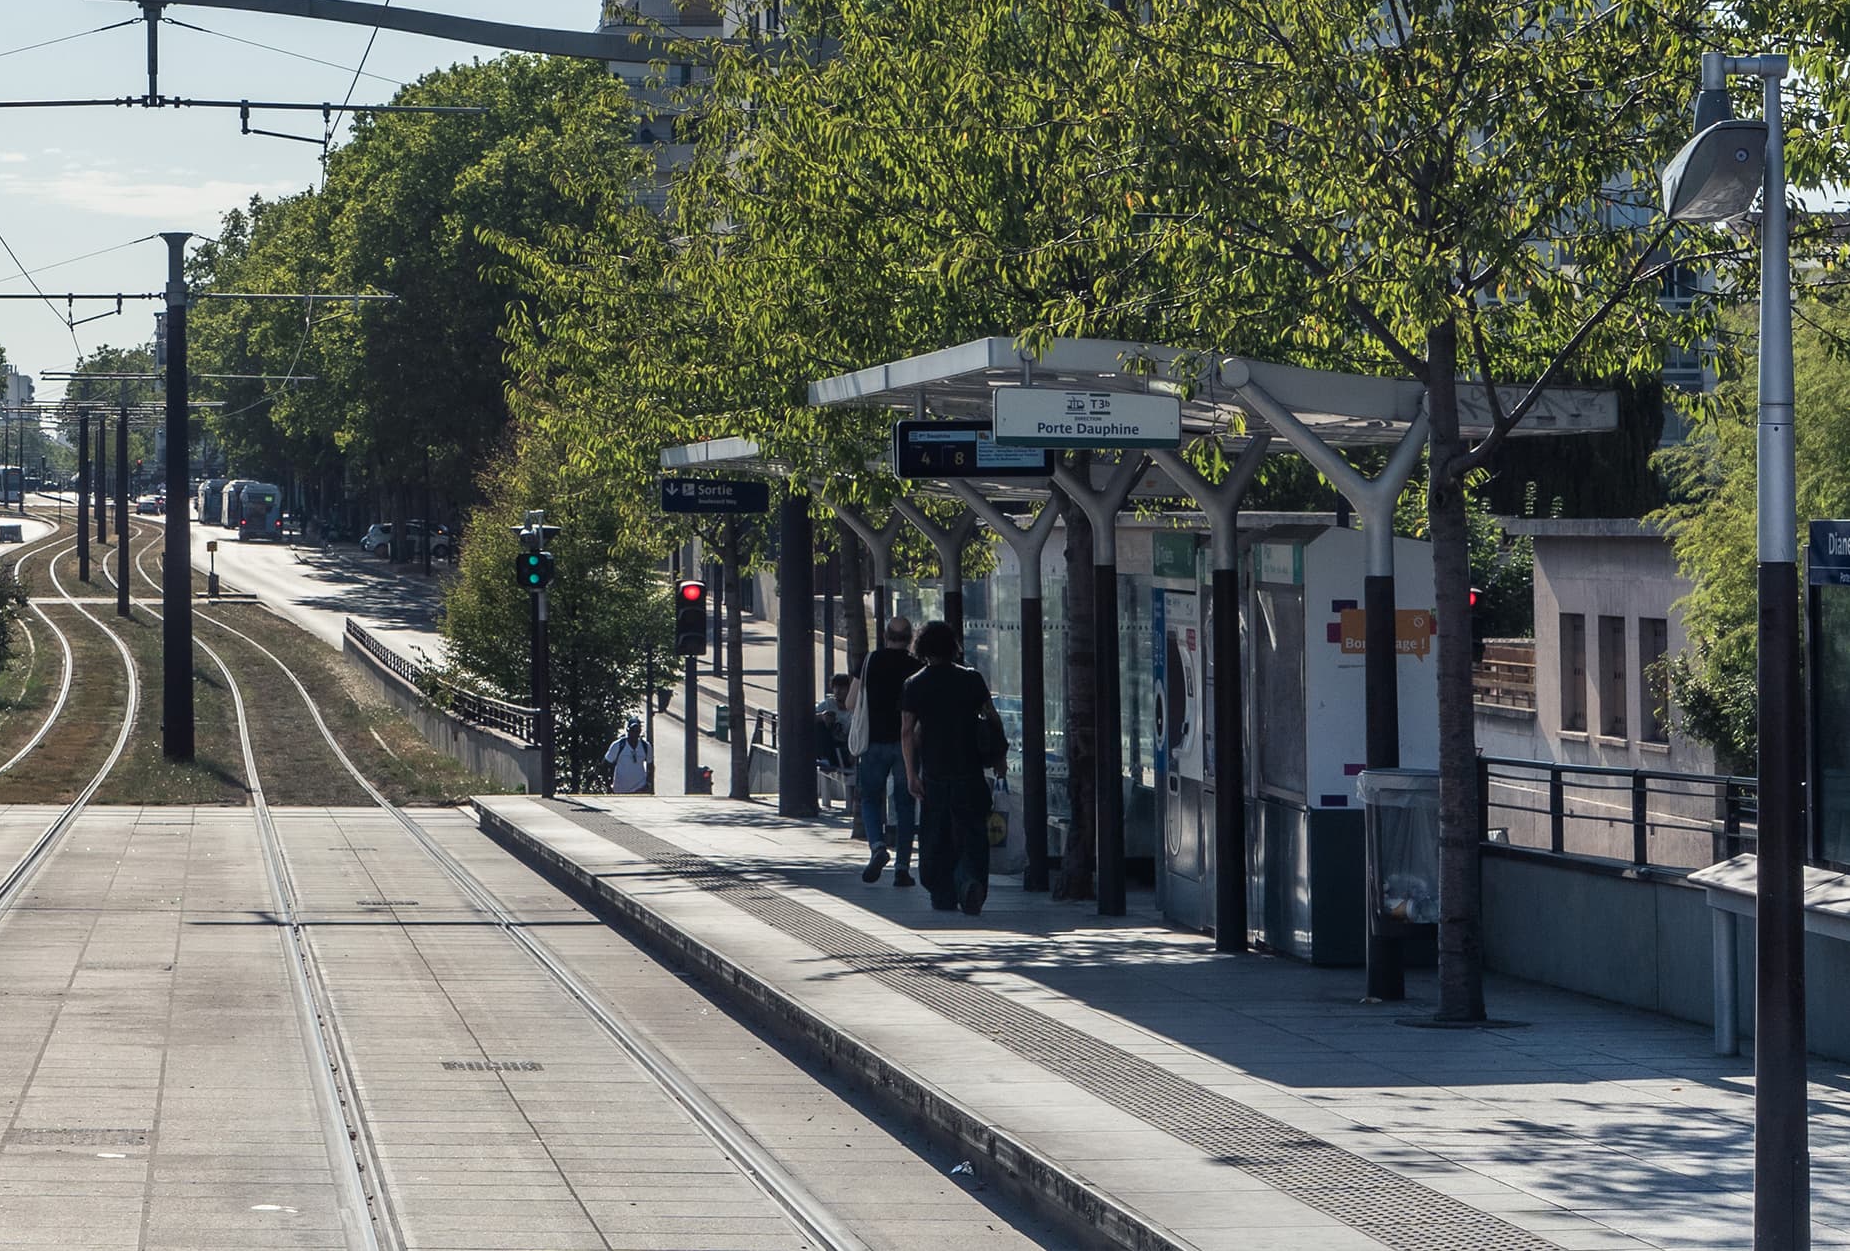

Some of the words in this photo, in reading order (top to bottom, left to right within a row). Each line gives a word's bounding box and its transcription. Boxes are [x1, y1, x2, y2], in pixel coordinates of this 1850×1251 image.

[1037, 422, 1073, 434] Porte
[1077, 423, 1139, 437] Dauphine
[921, 452, 931, 465] 4
[955, 451, 965, 465] 8
[698, 484, 733, 496] Sortie
